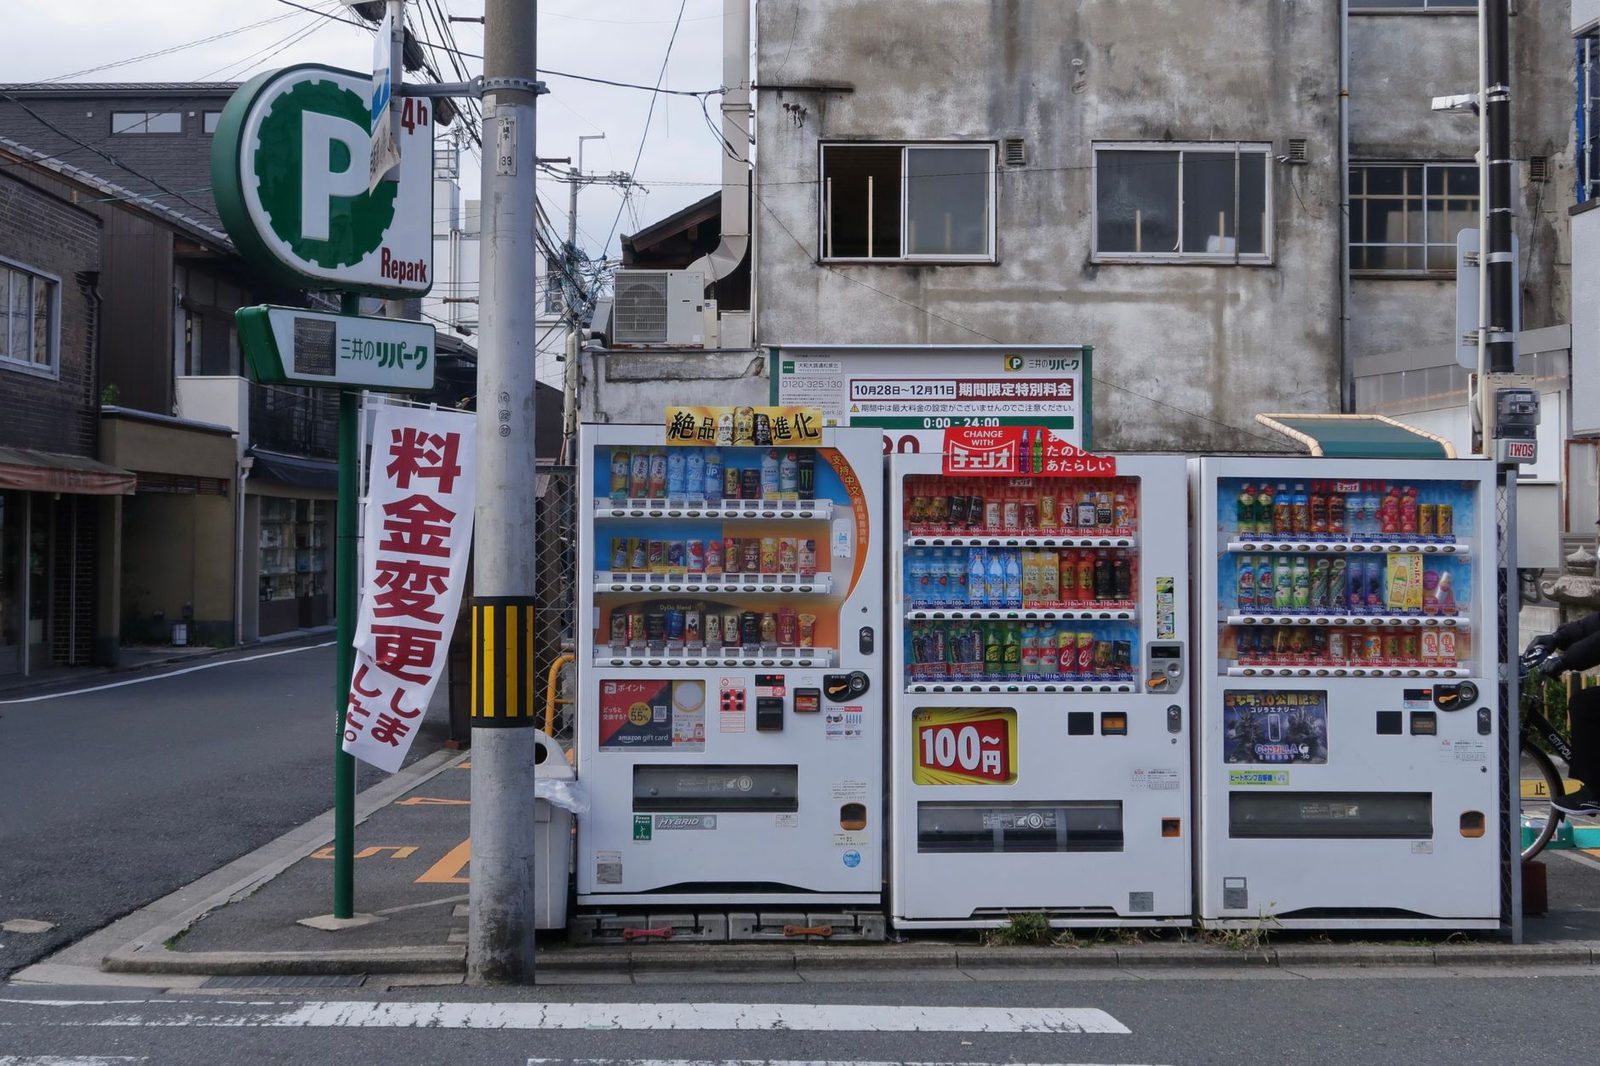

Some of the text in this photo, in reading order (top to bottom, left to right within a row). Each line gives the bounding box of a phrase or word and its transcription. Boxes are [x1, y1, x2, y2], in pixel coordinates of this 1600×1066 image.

[501, 156, 512, 166] 33
[302, 110, 373, 241] P
[381, 247, 427, 283] Repark
[341, 338, 428, 370] 三井のリパーク
[1028, 358, 1080, 370] 三井のリパーク
[959, 383, 1072, 397] 期間限定特別料金
[668, 411, 716, 440] 絶品
[771, 412, 819, 440] 進化
[923, 417, 951, 428] 0:00
[964, 418, 1000, 427] 24:00
[963, 430, 1003, 438] CHANGE
[1510, 444, 1534, 457] IWOS
[953, 447, 1010, 468] チェリオ
[1046, 459, 1112, 472] あたらしい
[370, 427, 462, 686] 料金変更
[618, 735, 642, 743] amazon
[643, 734, 655, 742] gift
[658, 816, 700, 828] HYBRID
